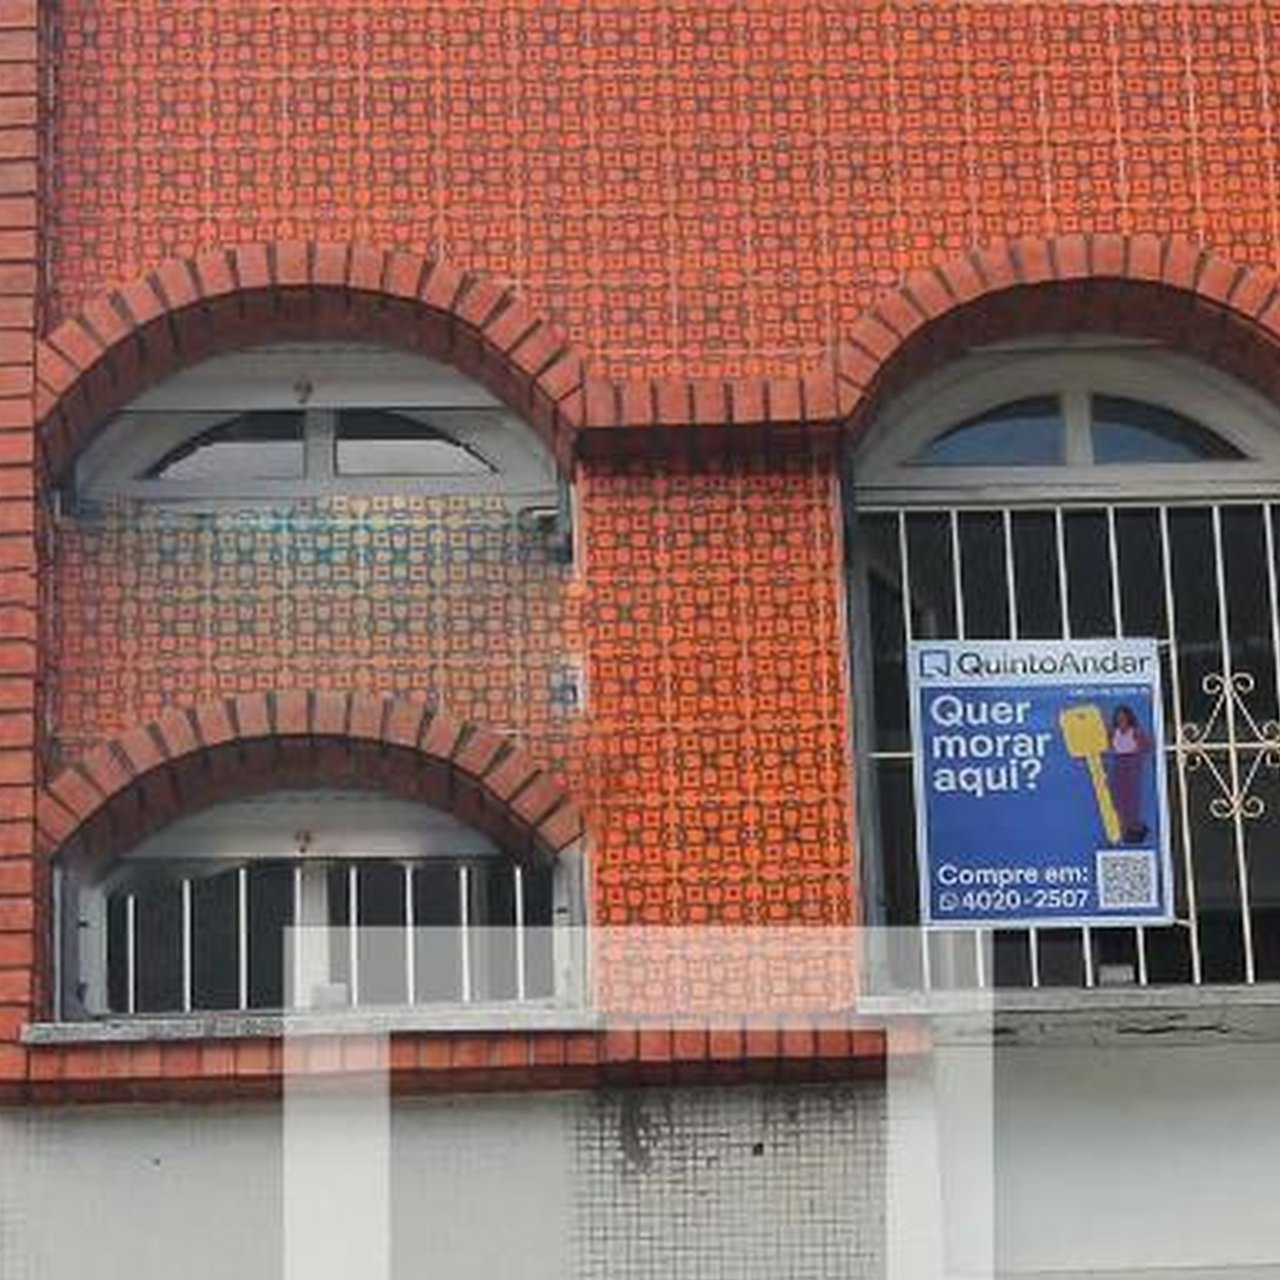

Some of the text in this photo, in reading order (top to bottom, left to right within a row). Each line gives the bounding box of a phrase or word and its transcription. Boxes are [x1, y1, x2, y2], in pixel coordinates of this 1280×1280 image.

[956, 651, 1152, 677] QuintoAndar
[931, 694, 1031, 726] Quer
[932, 729, 1052, 759] morar
[933, 758, 1043, 798] aqui?
[938, 864, 1089, 888] Compre em:
[962, 889, 1089, 910] 4020-2507
